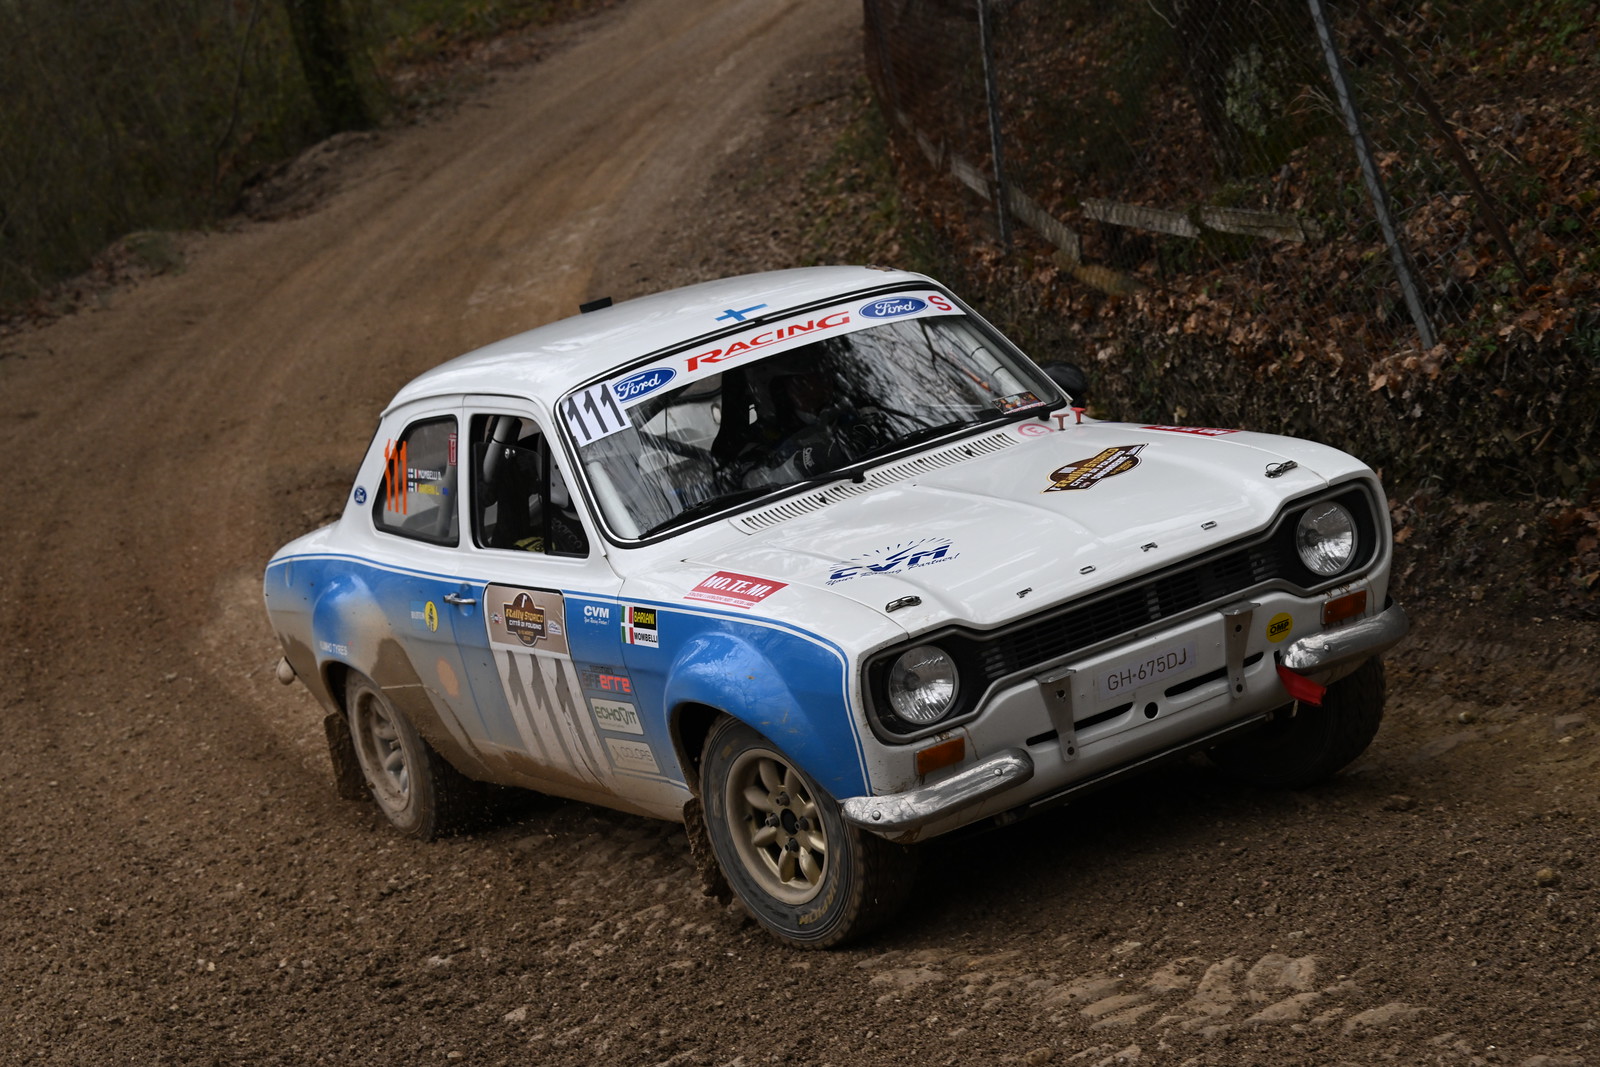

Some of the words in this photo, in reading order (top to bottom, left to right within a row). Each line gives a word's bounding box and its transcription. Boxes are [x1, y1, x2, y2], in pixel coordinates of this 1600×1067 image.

[617, 373, 662, 400] Ford
[684, 311, 851, 373] RACING
[875, 300, 916, 316] Ford
[927, 295, 952, 311] S
[566, 383, 626, 441] 111
[384, 438, 408, 515] 111
[829, 543, 951, 580] CVM
[505, 607, 524, 621] Rally
[583, 605, 610, 618] CVM
[633, 611, 655, 625] BARIANI
[634, 632, 658, 643] MOMBELLI
[1270, 620, 1290, 634] OMP
[506, 649, 607, 779] 111
